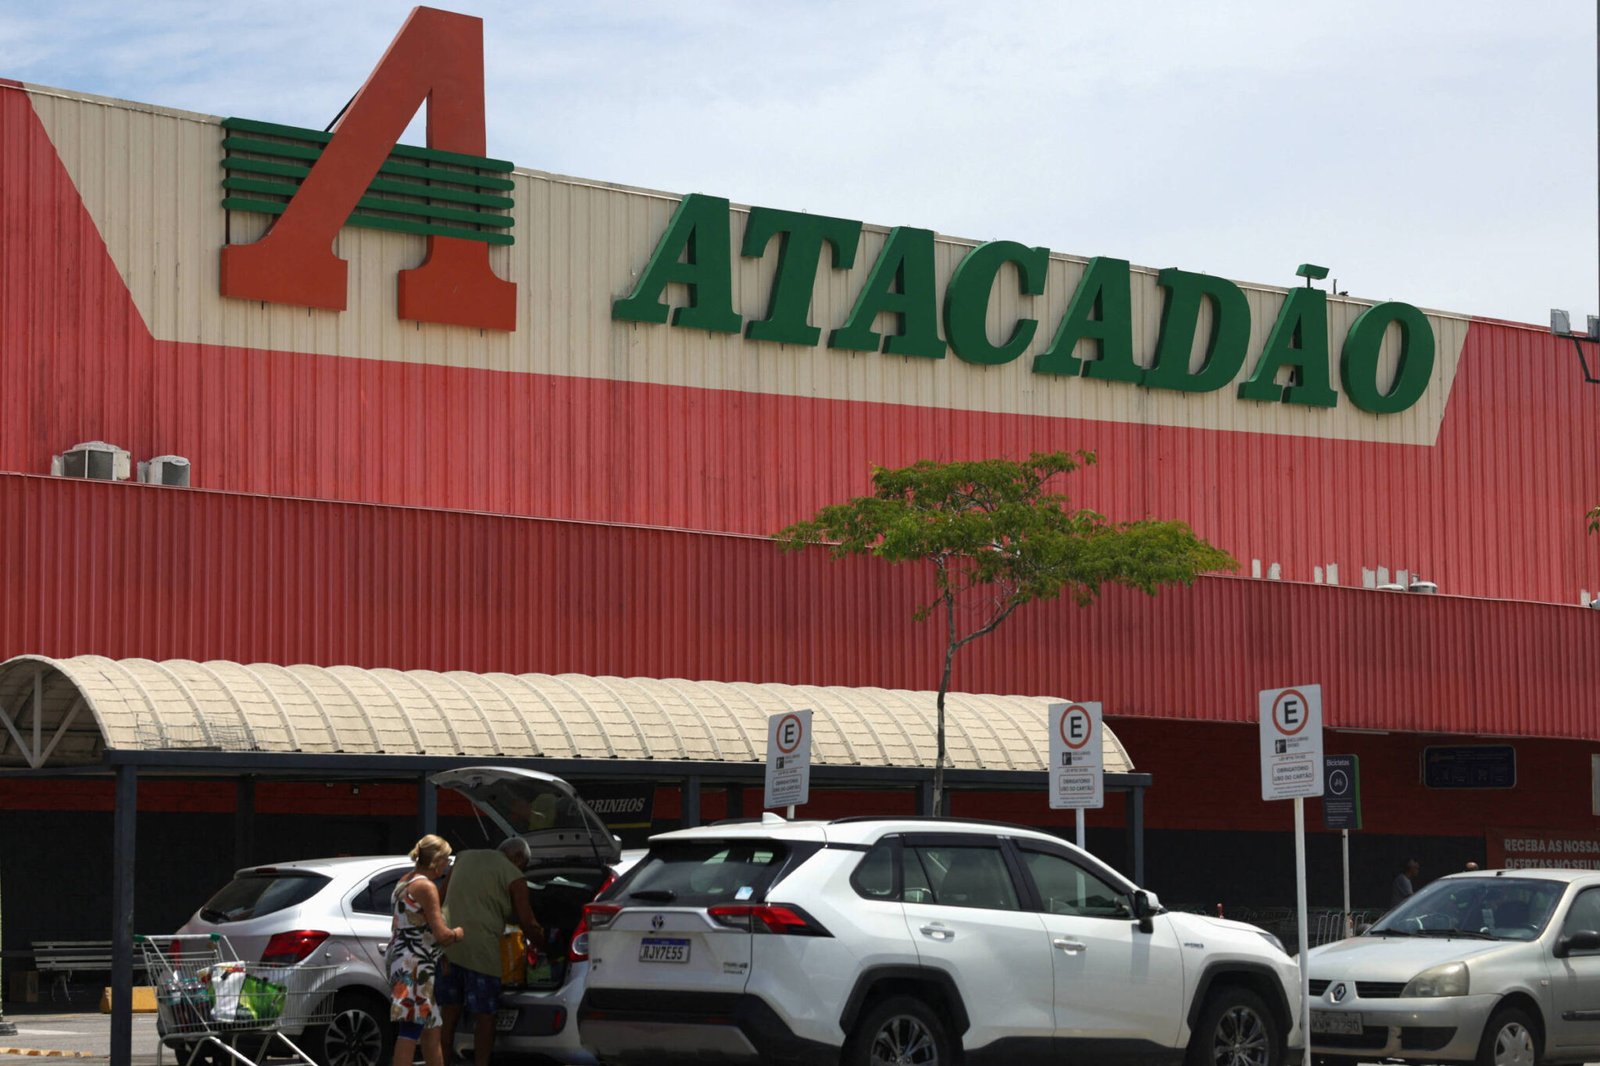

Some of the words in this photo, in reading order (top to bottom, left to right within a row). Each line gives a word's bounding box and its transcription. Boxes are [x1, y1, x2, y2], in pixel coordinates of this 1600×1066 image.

[219, 5, 517, 332] A
[611, 193, 1435, 414] ATACADÃO
[1284, 701, 1298, 724] E
[784, 724, 795, 744] E
[1070, 716, 1082, 738] E
[1327, 759, 1350, 767] Bicicletas
[1504, 839, 1546, 852] RECEBA
[1548, 840, 1562, 852] AS
[1563, 840, 1600, 853] NOSSA
[643, 945, 684, 960] RJY7E55
